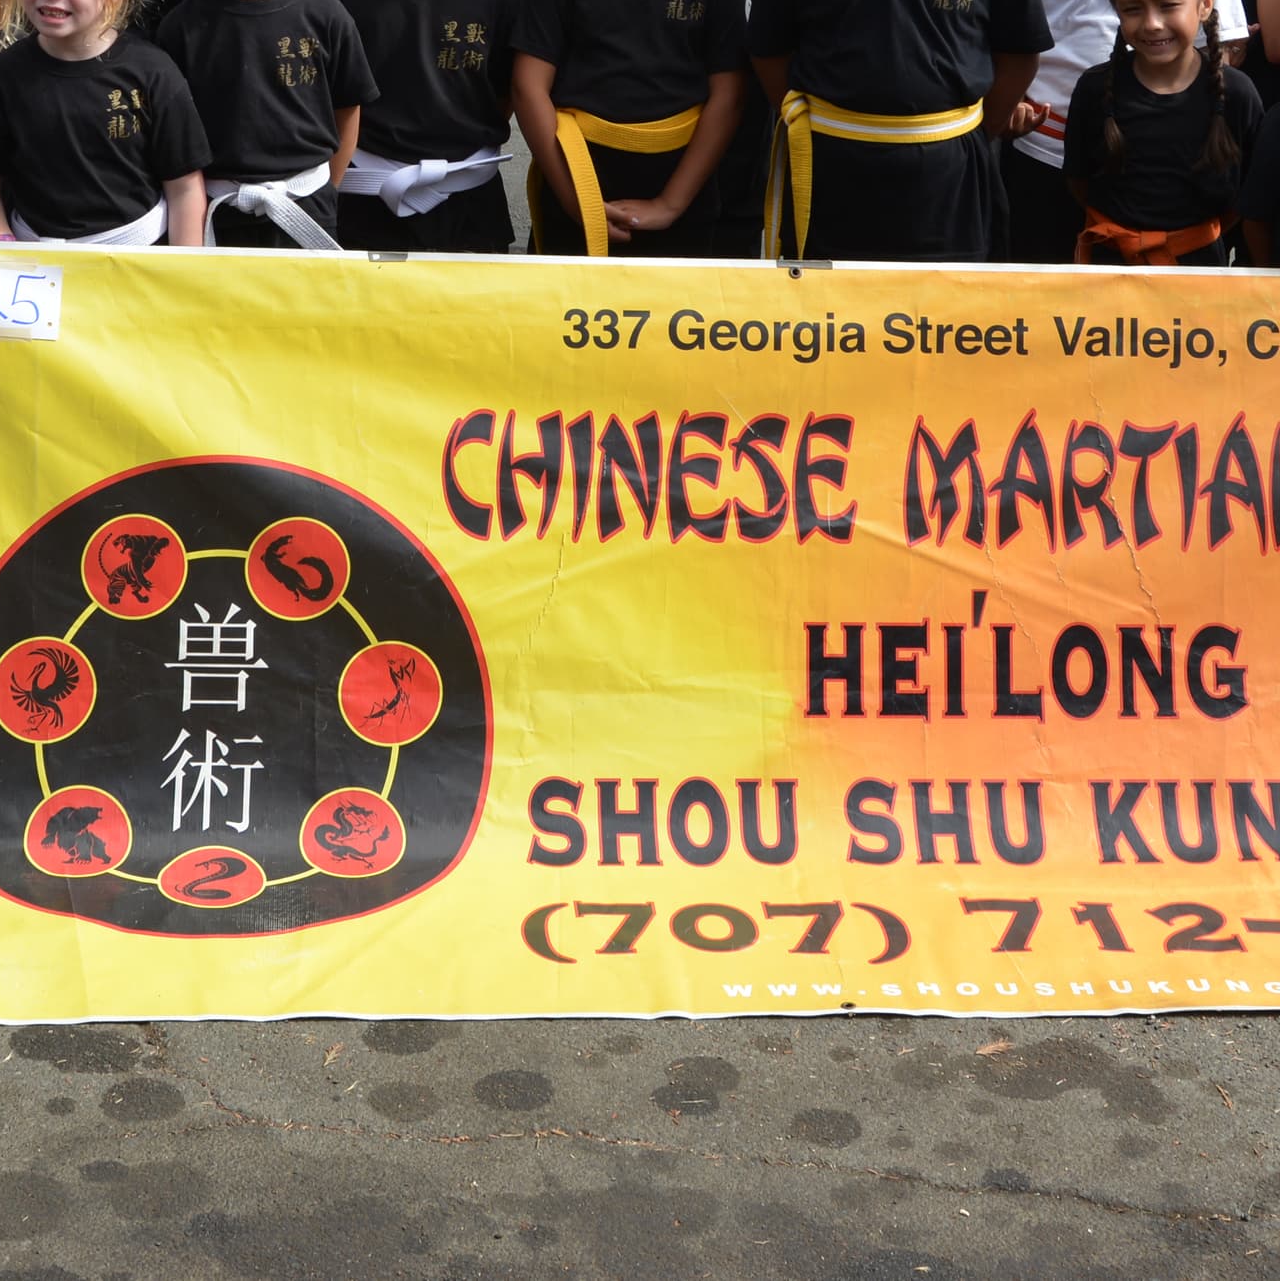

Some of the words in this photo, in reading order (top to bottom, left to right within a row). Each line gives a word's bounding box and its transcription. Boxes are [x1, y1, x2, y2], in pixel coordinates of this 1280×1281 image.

[563, 308, 651, 350] 337
[668, 310, 866, 364] Georgia
[883, 312, 1029, 357] Street
[1053, 316, 1228, 368] Vallejo,
[442, 408, 858, 545] CHINESE
[160, 602, 269, 835] 兽術
[527, 775, 799, 868] SHOU
[844, 776, 1048, 868] SHU
[520, 900, 913, 965] (707)
